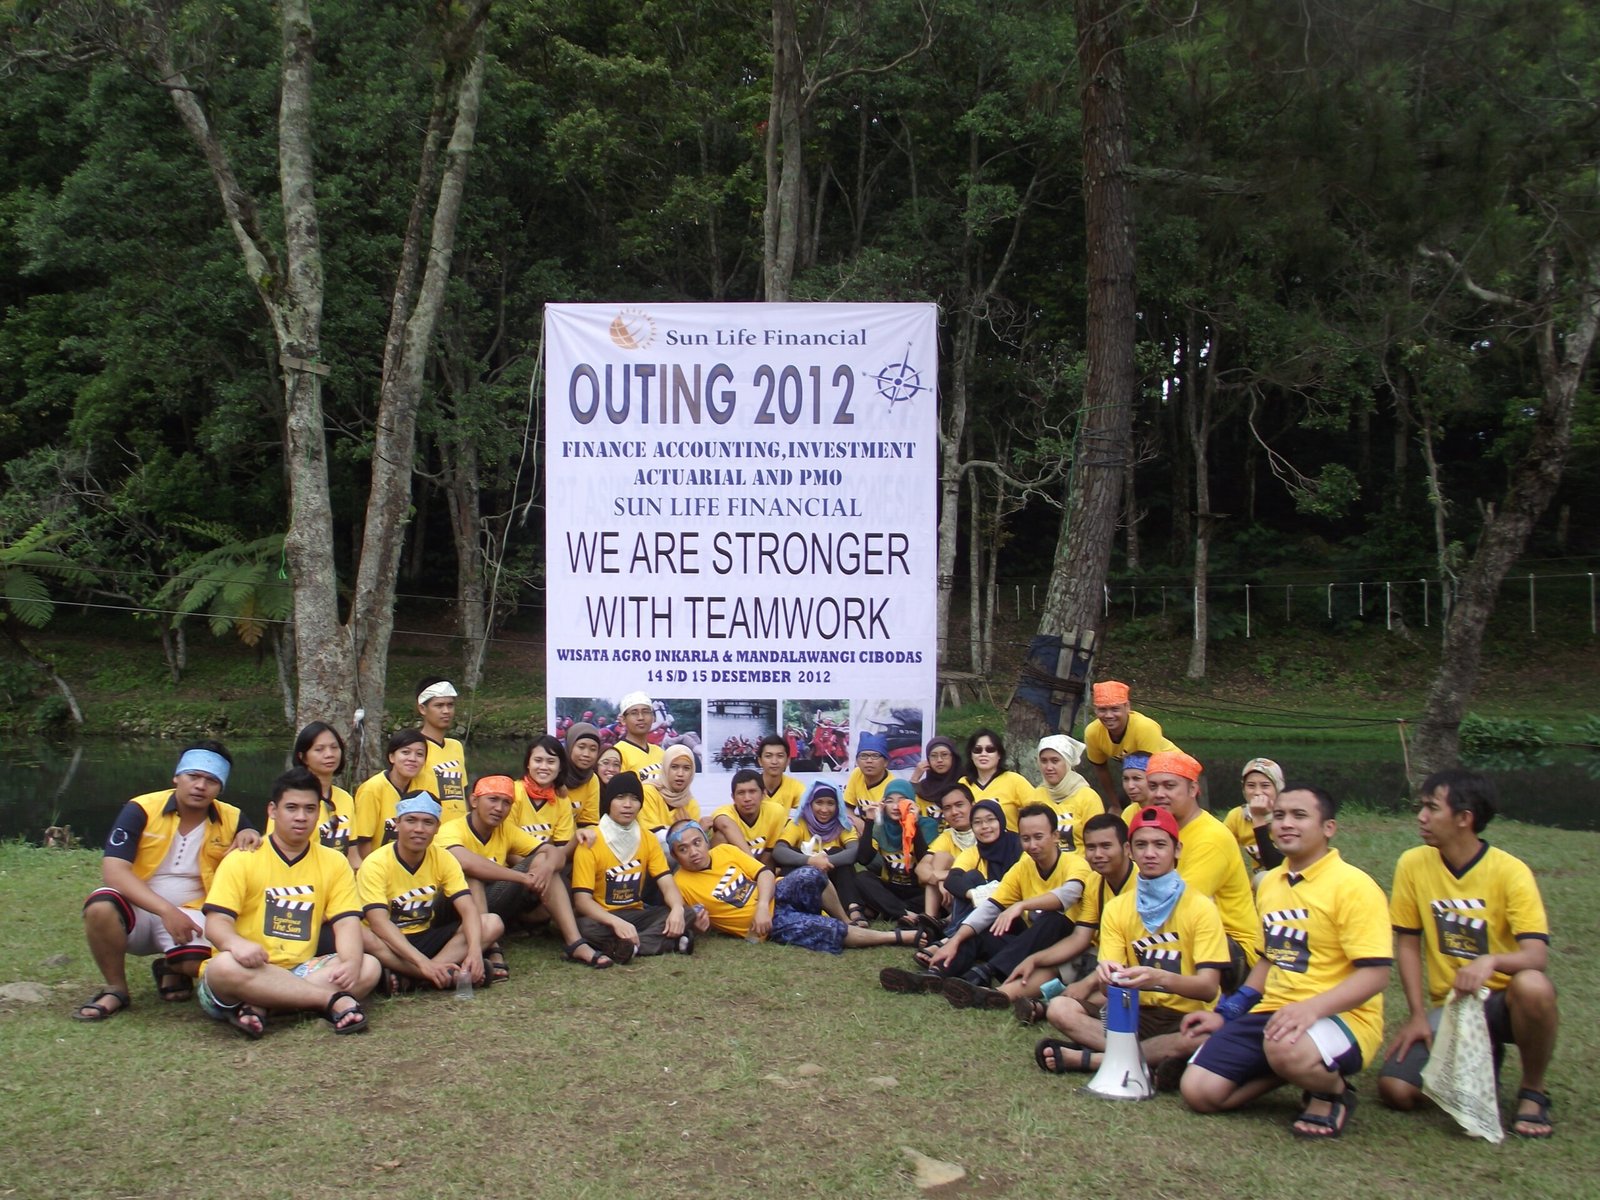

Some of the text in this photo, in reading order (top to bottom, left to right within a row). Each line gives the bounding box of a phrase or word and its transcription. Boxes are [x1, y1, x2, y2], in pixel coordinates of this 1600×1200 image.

[666, 328, 867, 346] Sun Life Financial
[569, 363, 737, 425] OUTING
[752, 364, 855, 425] 2012
[562, 441, 647, 458] FINANCE
[633, 468, 843, 486] ACTUARIAL AND PMO
[614, 496, 862, 517] SUN LIFE FINANCIAL
[566, 531, 620, 574] WE
[629, 531, 700, 574] ARE
[712, 531, 911, 576] STRONGER
[585, 595, 891, 640] WITH TEAMWORK
[556, 648, 923, 664] WISATA AGRO INKARLA & MANDALAWANGI CIBODAS
[647, 669, 831, 683] 14 S/D 15 DESEMBER 2012
